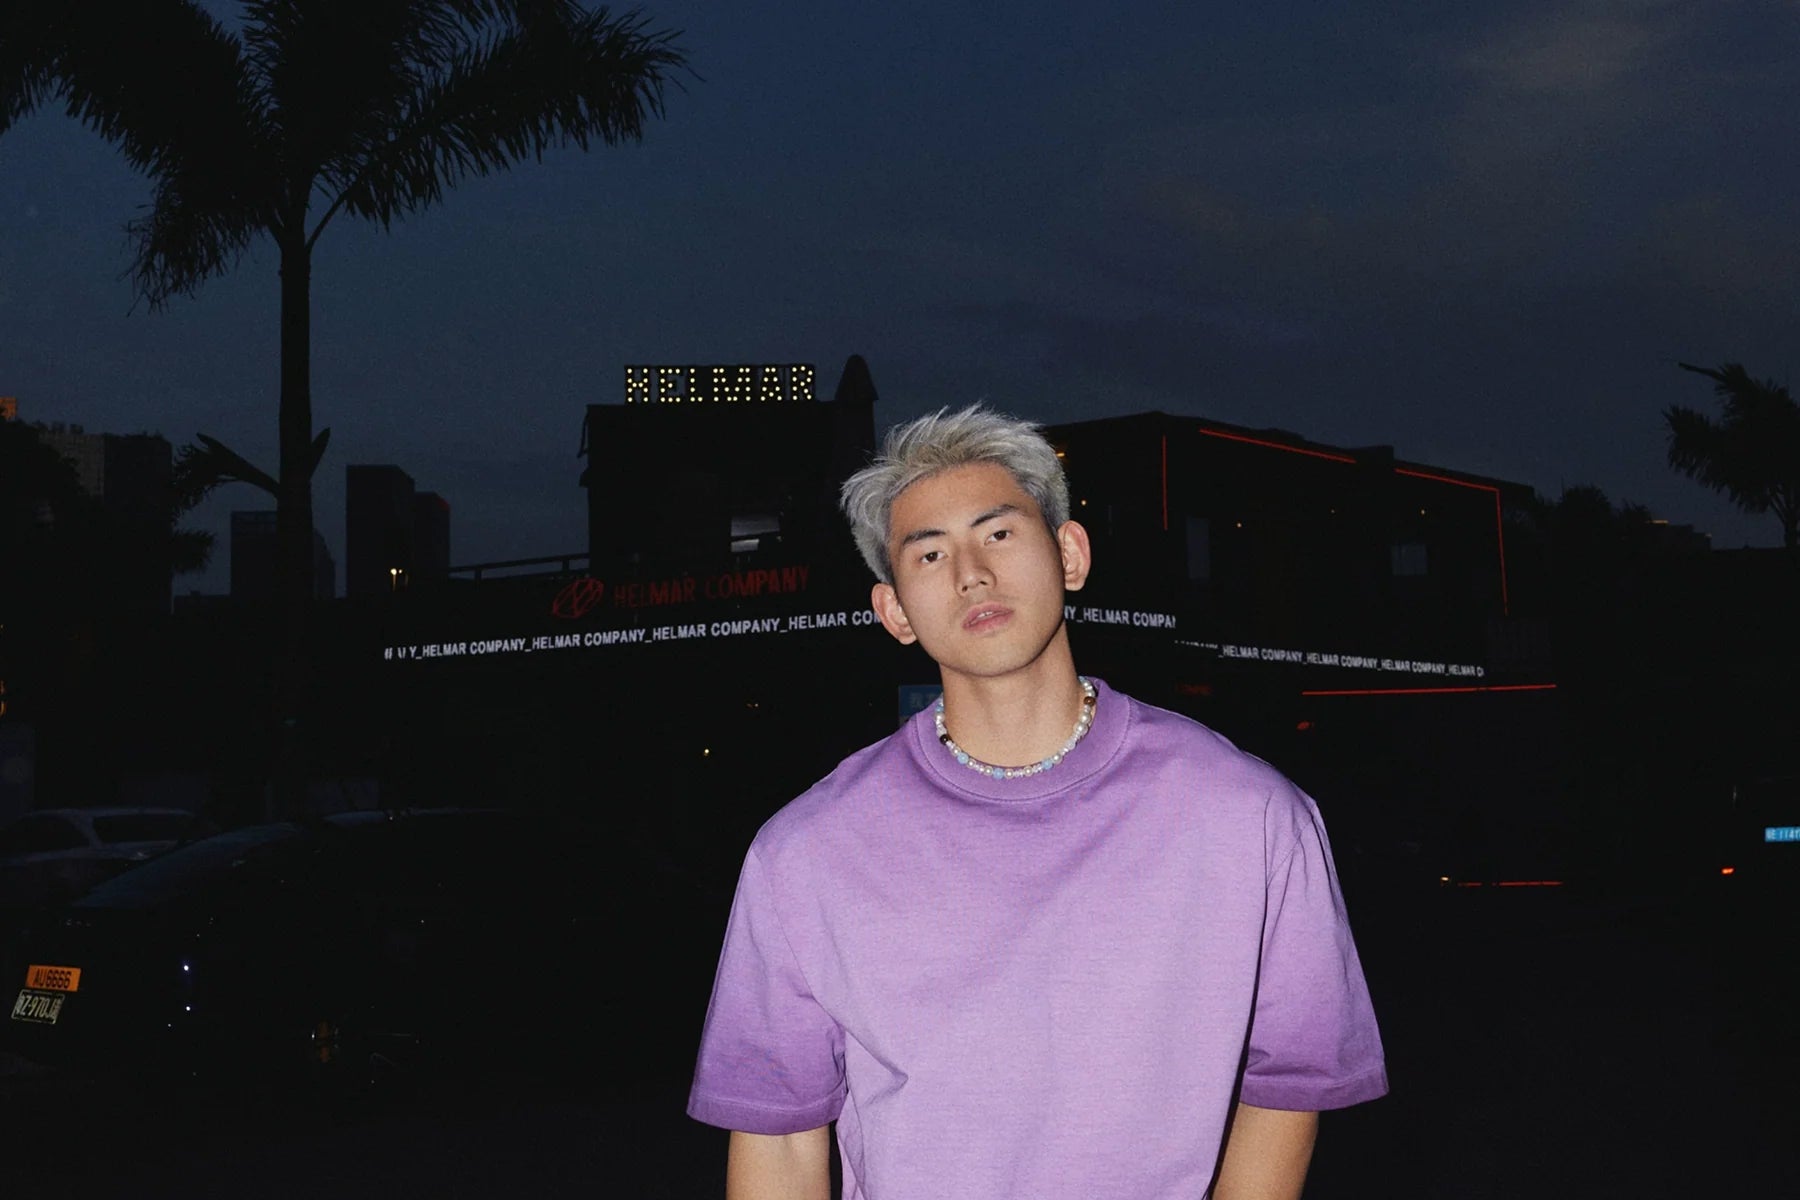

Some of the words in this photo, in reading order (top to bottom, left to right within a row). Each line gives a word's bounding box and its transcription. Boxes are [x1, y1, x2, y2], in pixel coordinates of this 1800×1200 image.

[626, 365, 814, 402] HELMAR
[614, 576, 697, 608] HELMAR
[704, 565, 810, 600] COMPANY
